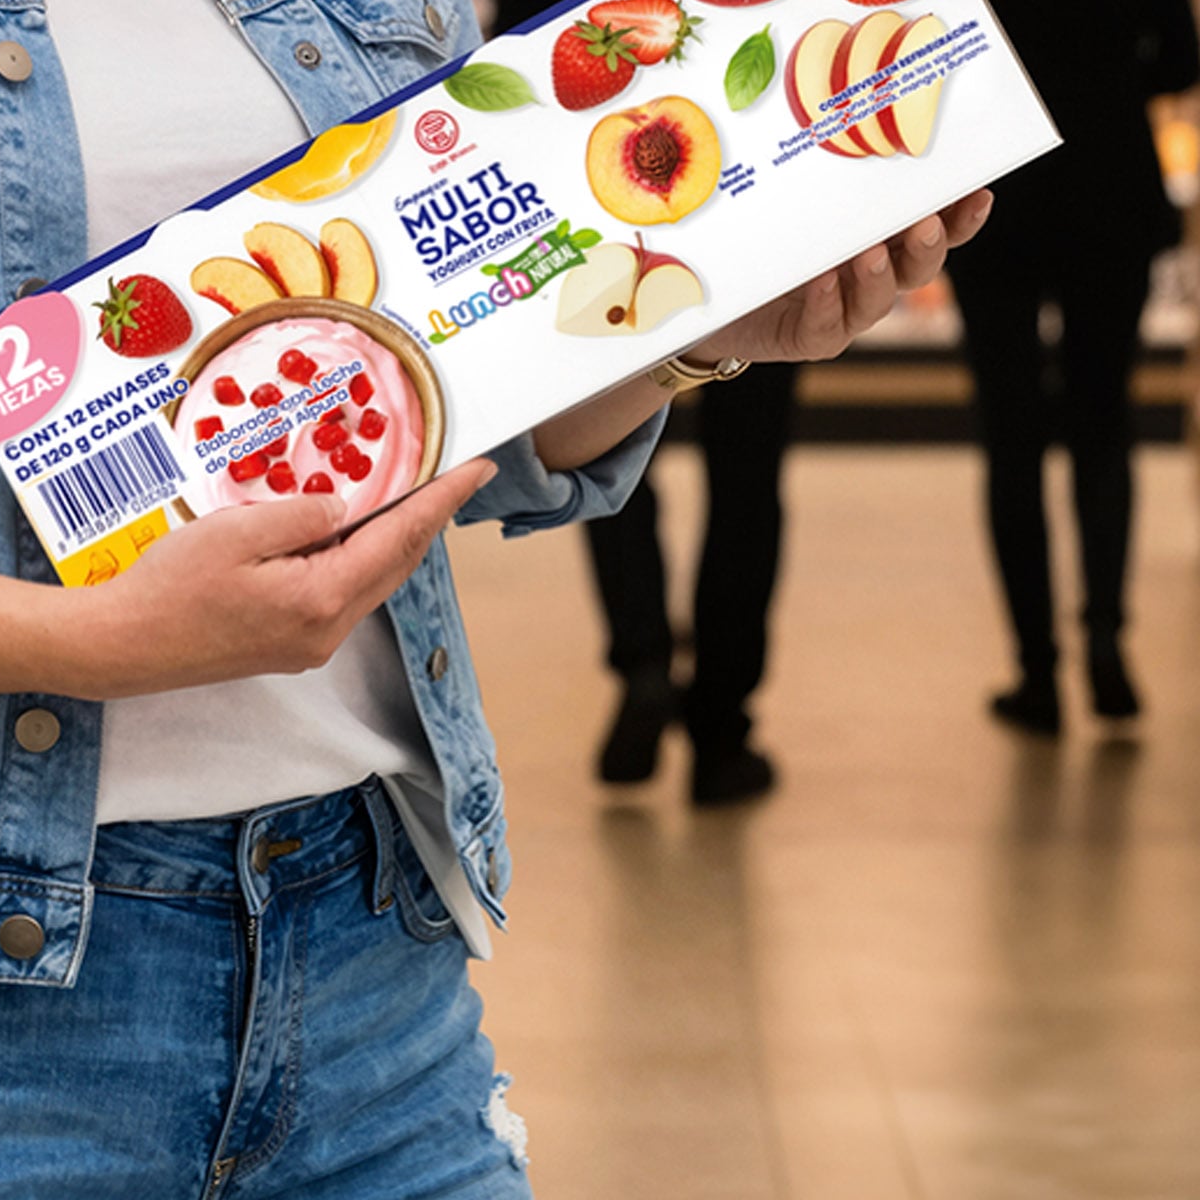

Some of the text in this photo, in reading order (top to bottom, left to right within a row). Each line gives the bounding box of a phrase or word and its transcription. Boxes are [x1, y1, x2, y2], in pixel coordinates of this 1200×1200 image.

[399, 161, 512, 240] MULTI
[415, 181, 544, 265] SABOR
[427, 243, 485, 281] YOGHURT
[486, 228, 515, 250] CON
[514, 207, 554, 234] FRUTA
[428, 267, 533, 337] Lunch
[4, 362, 170, 460] CONT. 12 ENVASES
[14, 378, 188, 482] DE 120 g CADA UNO
[194, 361, 361, 458] Elaborado con Leche
[205, 389, 348, 473] de Calidad Alpura
